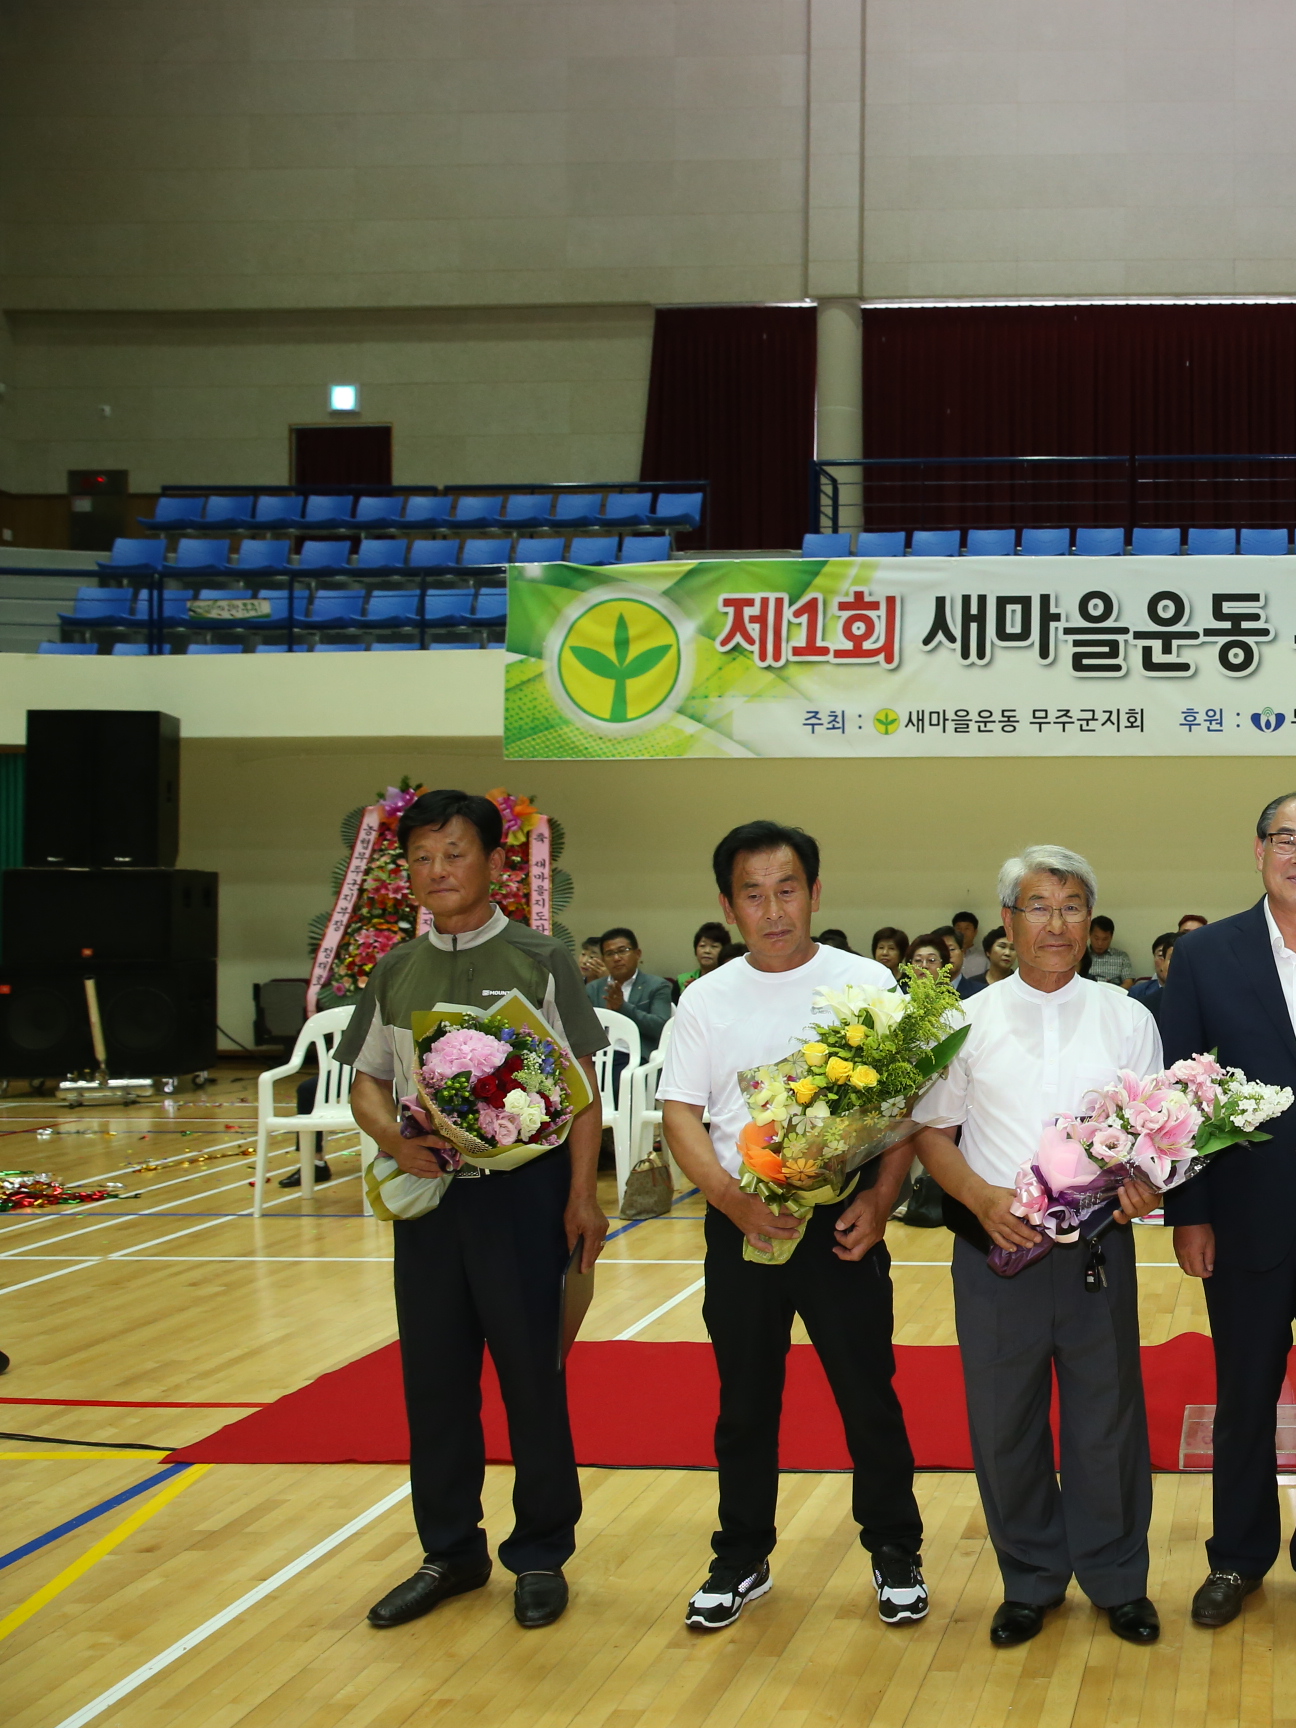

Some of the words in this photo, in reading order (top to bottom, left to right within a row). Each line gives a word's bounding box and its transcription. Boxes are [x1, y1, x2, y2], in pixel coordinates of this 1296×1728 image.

[720, 591, 898, 665] 제1회
[923, 590, 1270, 674] 새마을운동
[802, 710, 845, 735] 주최
[904, 708, 1020, 734] 새마을운동
[1028, 708, 1145, 734] 무주군지회
[1178, 708, 1224, 734] 후원
